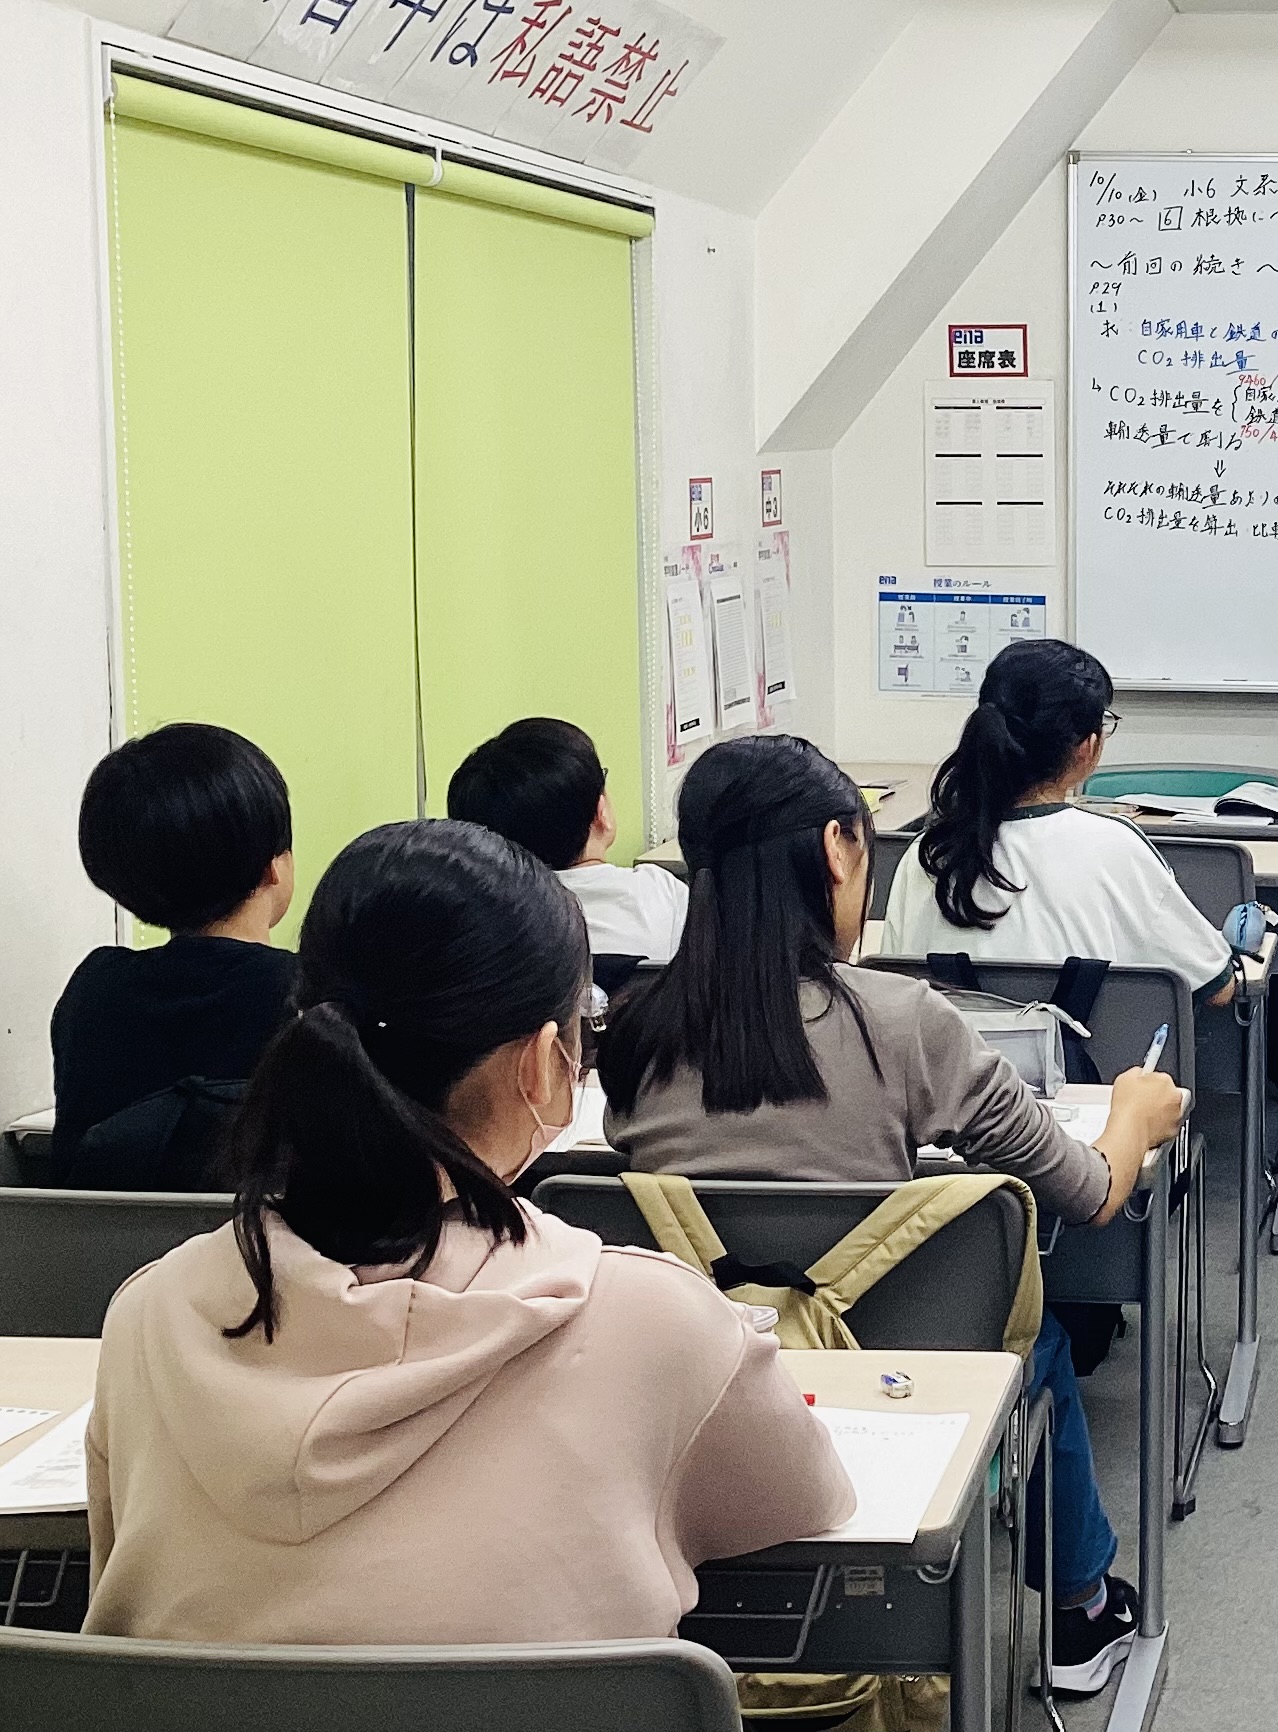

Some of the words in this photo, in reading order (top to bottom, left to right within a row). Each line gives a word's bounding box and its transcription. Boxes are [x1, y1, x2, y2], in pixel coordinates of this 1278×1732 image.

[1184, 178, 1216, 198] 小6
[1090, 302, 1118, 314] (1)
[953, 329, 984, 345] ena
[957, 349, 1017, 369] 座席表
[694, 506, 709, 533] 小6
[879, 575, 897, 585] ena
[933, 578, 992, 589] 授業のルール
